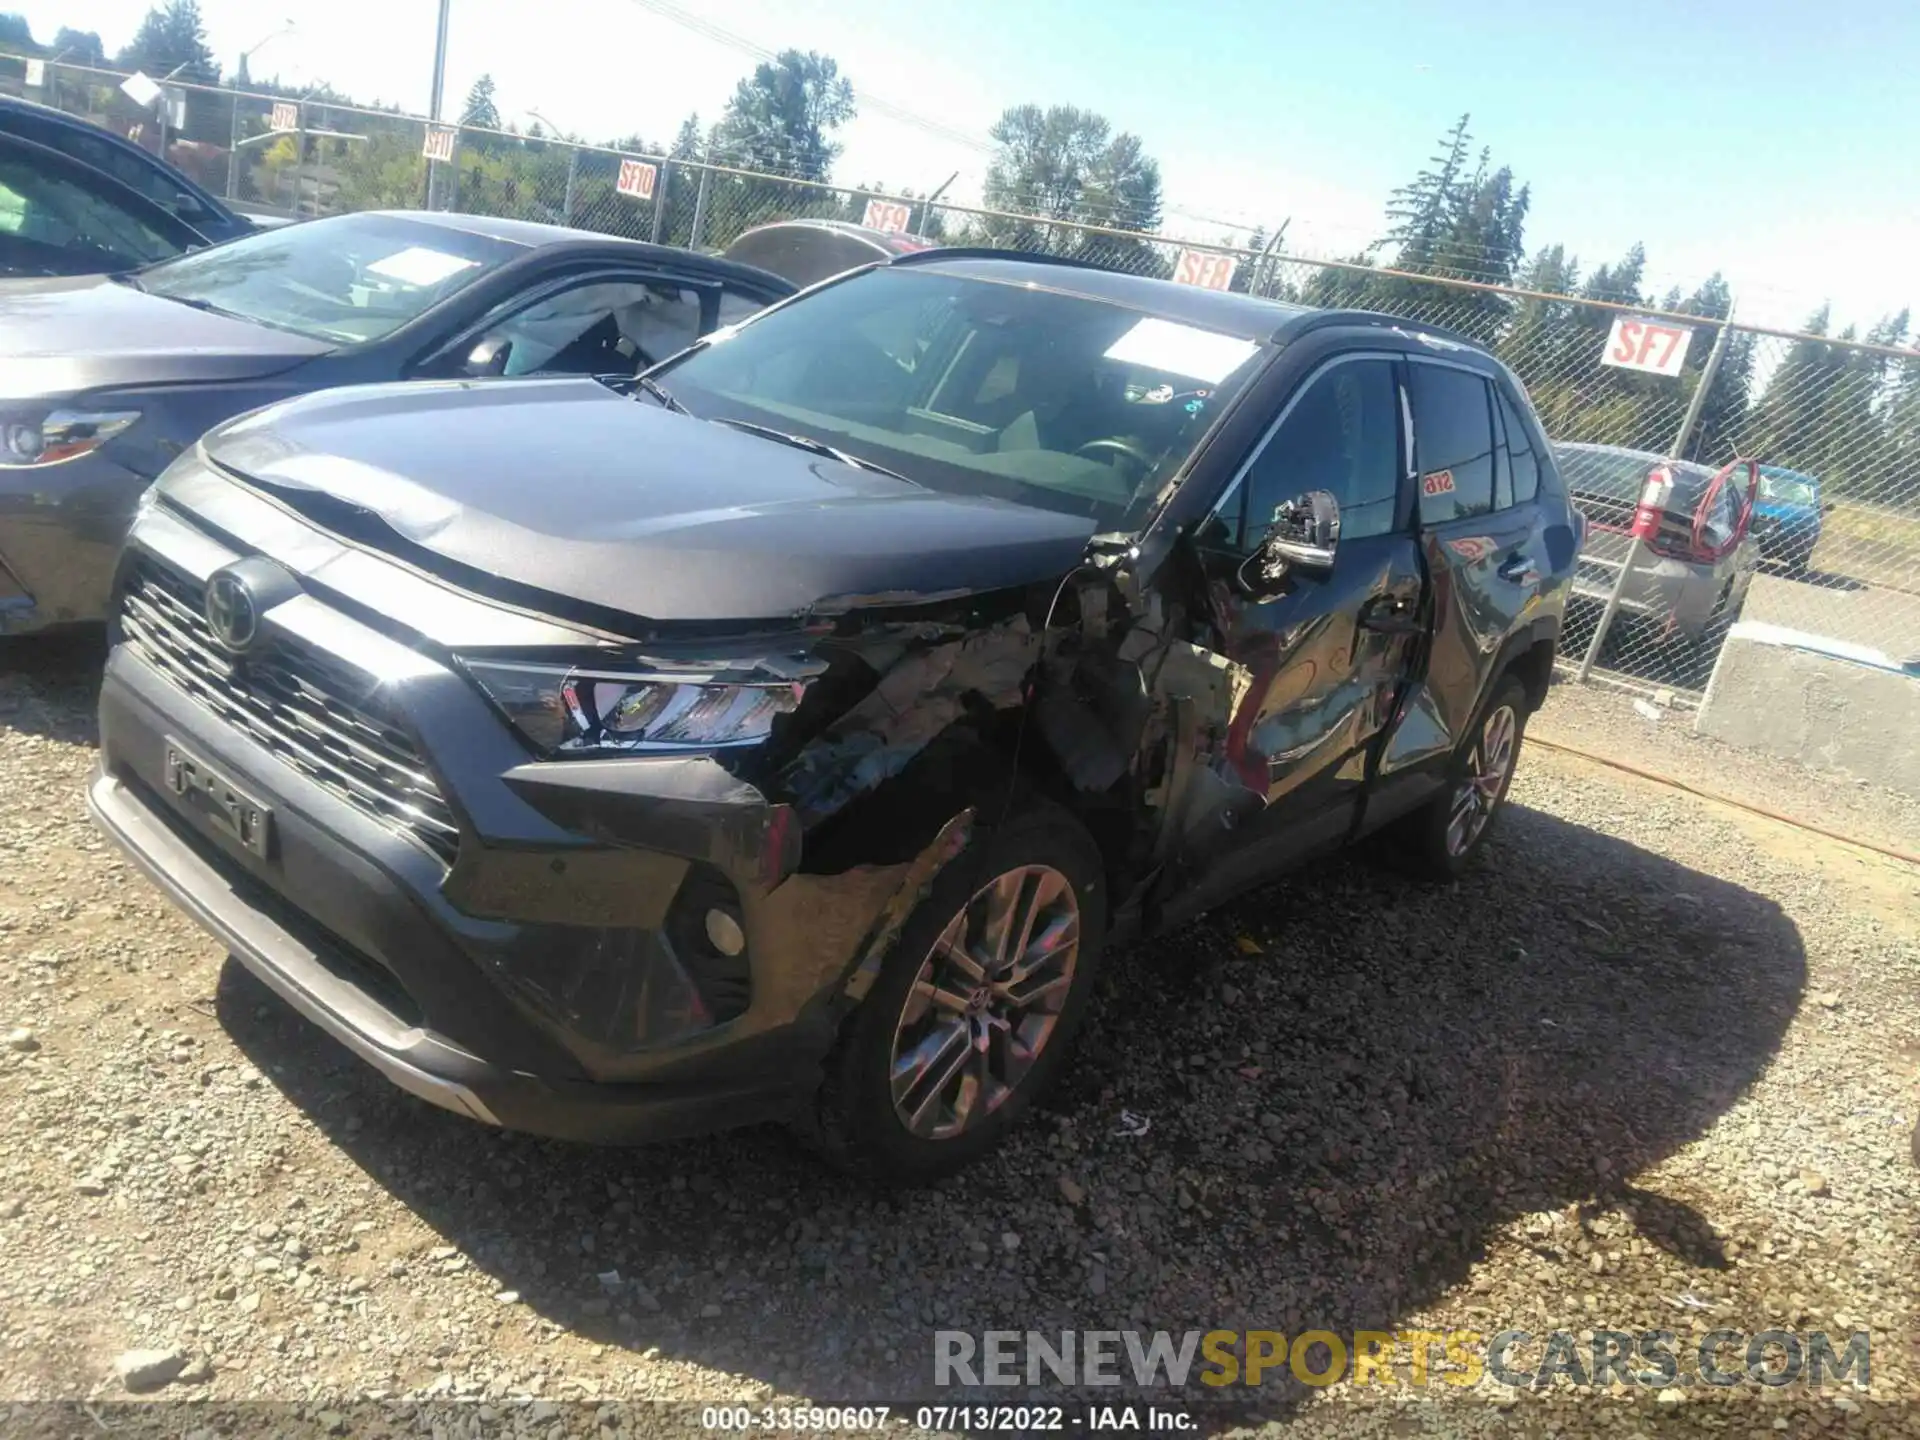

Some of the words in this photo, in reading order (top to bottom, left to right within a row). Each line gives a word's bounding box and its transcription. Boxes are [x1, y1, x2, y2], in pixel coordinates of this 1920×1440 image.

[620, 162, 654, 194] SF10
[866, 203, 907, 231] SF9
[1178, 252, 1232, 290] SF8
[1613, 320, 1682, 368] SF7
